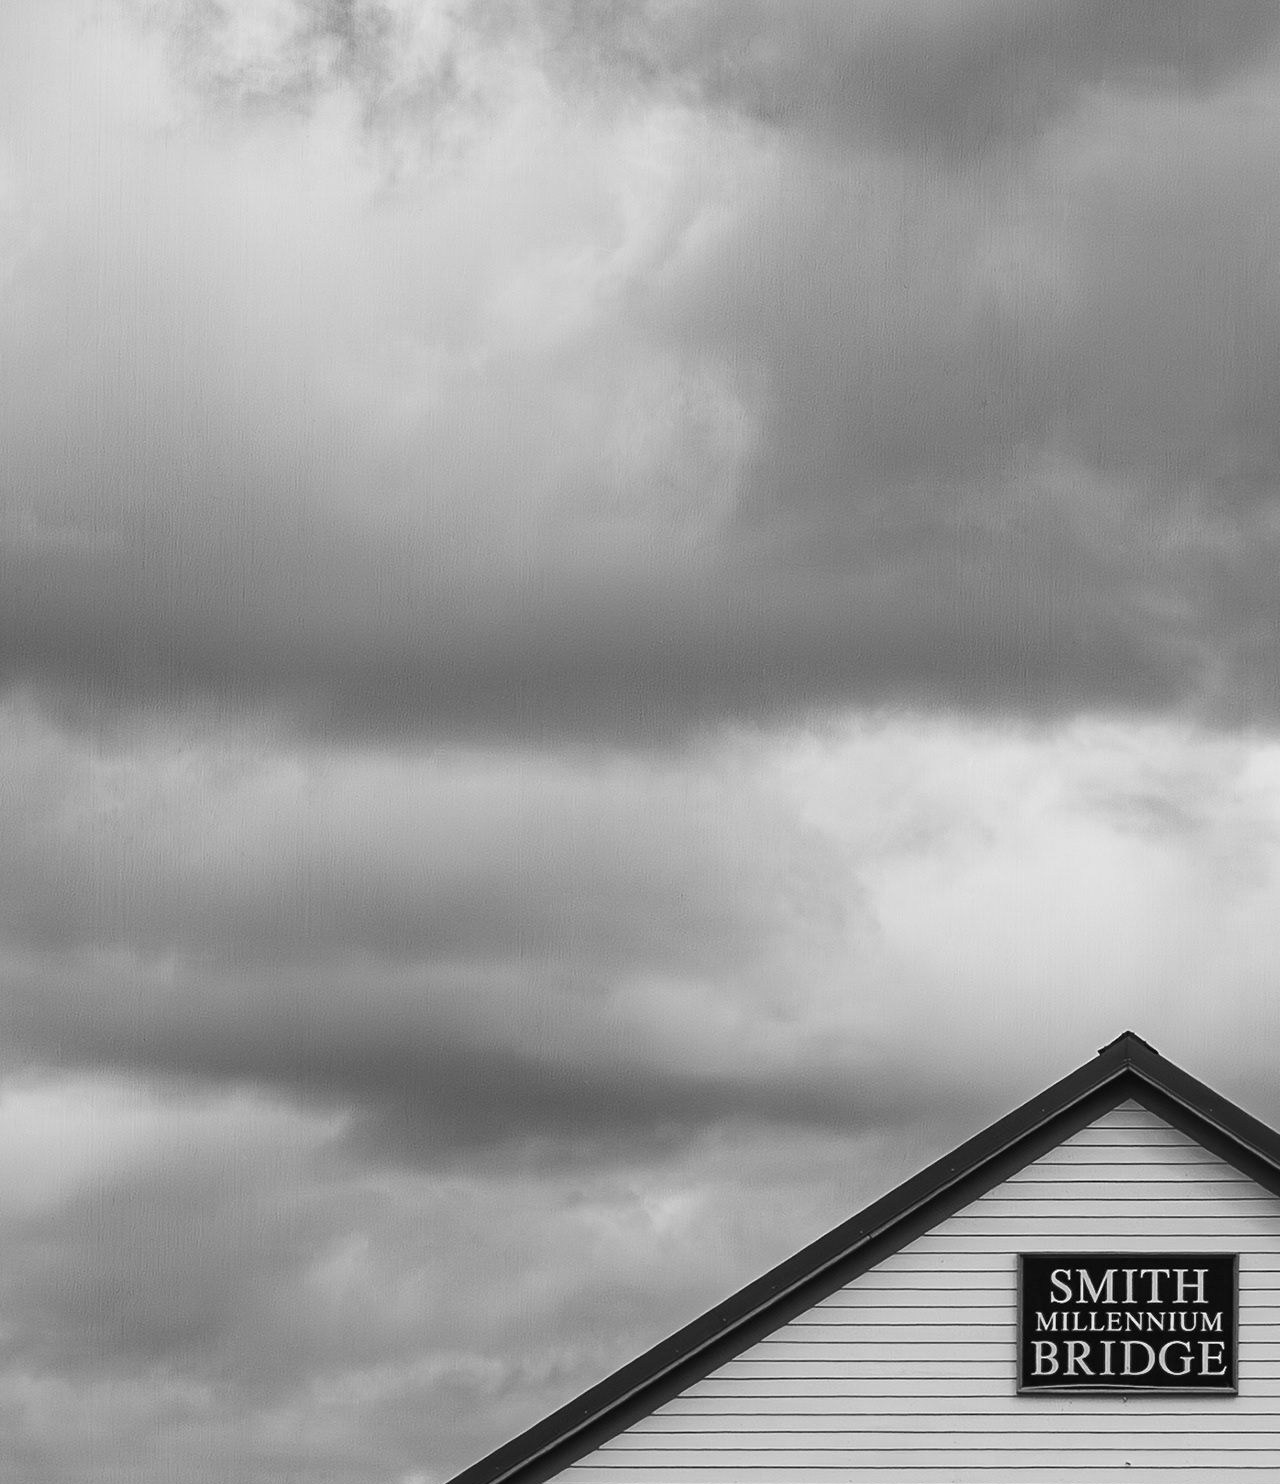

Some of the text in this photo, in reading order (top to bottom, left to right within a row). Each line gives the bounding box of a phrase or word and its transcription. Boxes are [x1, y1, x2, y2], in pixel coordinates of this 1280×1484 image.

[1050, 1268, 1209, 1304] SMITH
[1035, 1311, 1223, 1332] MILLENNIUM
[1030, 1340, 1227, 1376] BRIDGE
